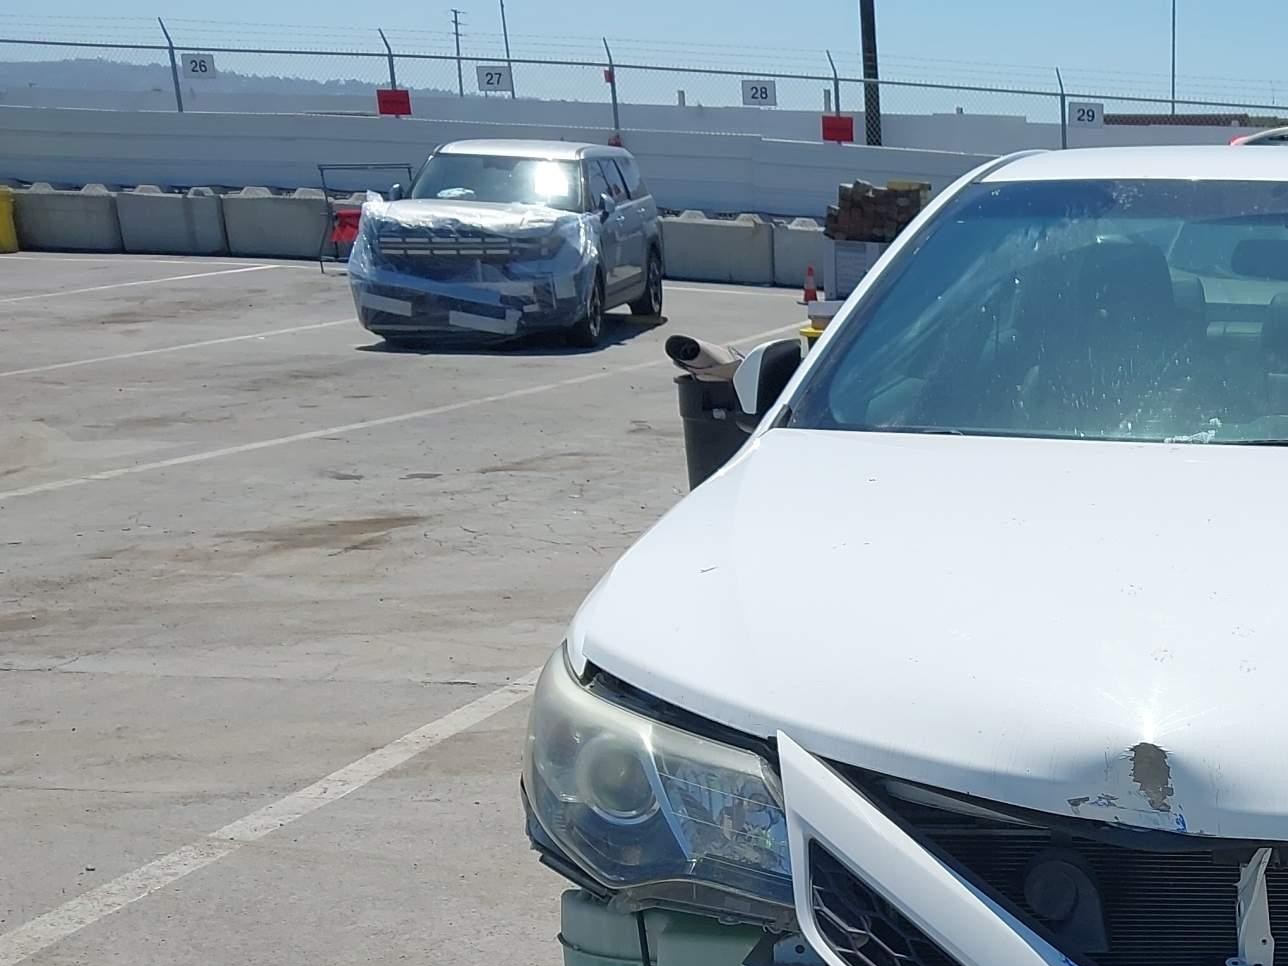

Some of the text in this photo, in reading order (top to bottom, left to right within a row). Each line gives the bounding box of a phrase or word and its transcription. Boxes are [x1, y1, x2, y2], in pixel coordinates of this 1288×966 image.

[190, 59, 208, 73] 26
[485, 72, 502, 85] 27
[750, 86, 768, 100] 28
[1077, 108, 1095, 122] 29
